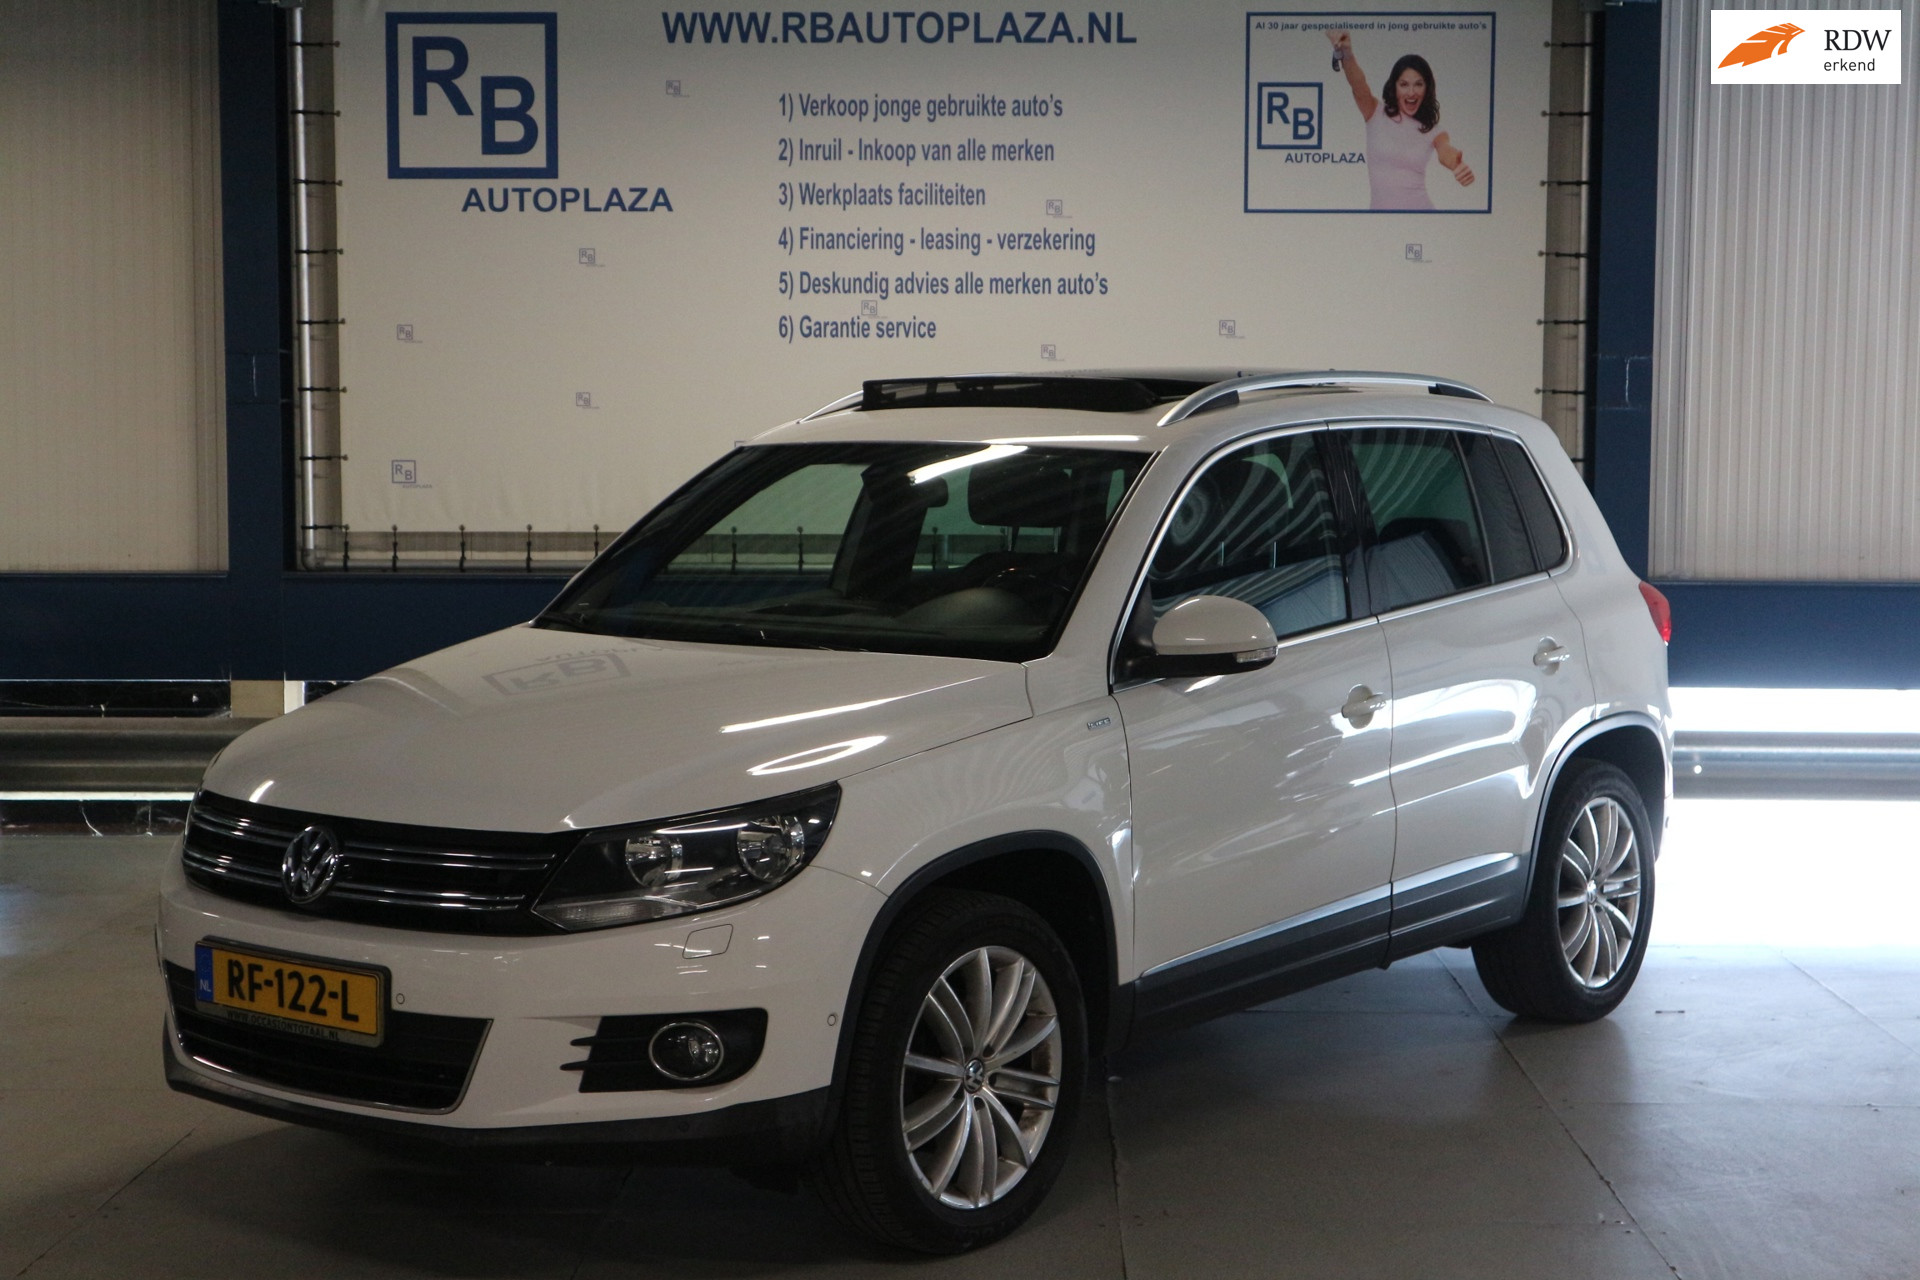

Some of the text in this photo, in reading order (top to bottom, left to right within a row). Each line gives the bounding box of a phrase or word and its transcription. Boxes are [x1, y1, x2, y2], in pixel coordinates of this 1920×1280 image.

[662, 12, 1136, 43] WWW.RBAUTOPLAZA.NL
[1281, 23, 1298, 31] jaar
[1301, 22, 1374, 31] gespecialiseerd
[1388, 22, 1409, 31] jong
[1412, 22, 1455, 31] gebruikte
[412, 36, 538, 155] RB
[779, 93, 1062, 122] 1) Verkoop jonge gebruikte auto's
[1267, 92, 1315, 140] RB
[779, 138, 793, 166] 2)
[800, 138, 841, 160] Inruil
[859, 138, 916, 166] Inkoop
[922, 144, 951, 160] van
[957, 138, 986, 161] alle
[992, 139, 1054, 161] merken
[1285, 153, 1365, 163] AUTOPLAZA
[462, 187, 673, 212] AUTOPLAZA
[779, 182, 985, 211] 3) Werkplaats faciliteiten
[779, 227, 793, 255] 4)
[800, 227, 903, 256] Financiering
[921, 227, 980, 256] leasing
[997, 228, 1095, 256] verzekering
[779, 271, 1108, 300] 5) Deskundig advies alle merken auto's
[779, 315, 936, 343] 6) Garantie service
[395, 464, 413, 480] RB
[227, 959, 359, 1022] RF-122-L
